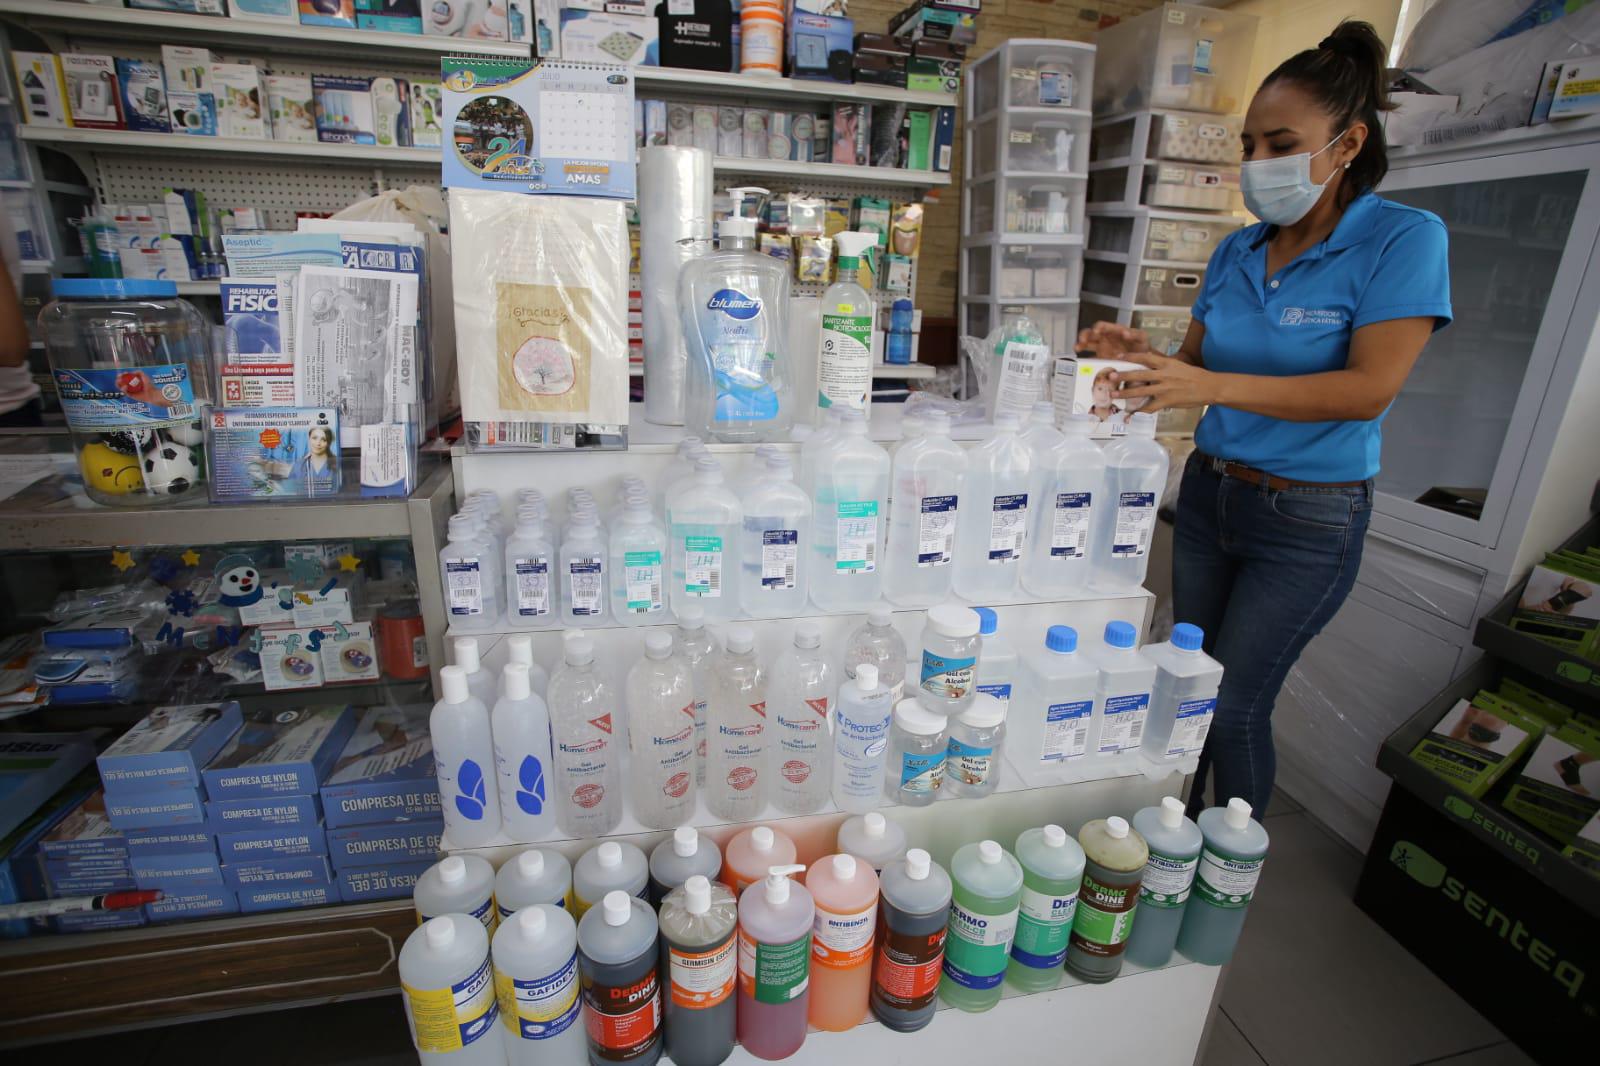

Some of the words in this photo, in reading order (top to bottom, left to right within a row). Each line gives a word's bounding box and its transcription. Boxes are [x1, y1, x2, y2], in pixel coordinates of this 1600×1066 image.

[566, 174, 601, 185] AMAS
[709, 297, 762, 309] blumen
[945, 677, 971, 685] Alcohol
[960, 763, 988, 773] Alcohol
[220, 778, 261, 788] COMPRESA
[262, 776, 273, 785] DE
[273, 772, 298, 784] NYLON
[341, 798, 404, 813] COMPRESA
[405, 796, 422, 808] DE
[222, 811, 261, 820] COMPRESA
[262, 808, 273, 818] DE
[273, 805, 299, 817] NYLON
[233, 840, 272, 851] COMPRESA
[274, 838, 284, 848] DE
[284, 835, 309, 847] NYLON
[346, 842, 406, 856] COMPRESA
[408, 840, 424, 851] DE
[426, 838, 441, 849] GE
[348, 879, 371, 893] GEL
[371, 877, 388, 890] DE
[389, 873, 418, 888] RESA
[1083, 875, 1128, 897] DERMO
[253, 892, 291, 904] COMPRESA
[291, 890, 301, 901] DE
[301, 888, 326, 900] NYLON
[1095, 892, 1125, 905] DINE
[527, 967, 575, 998] GAFIDEX
[610, 970, 657, 1000] DERMO
[628, 979, 657, 1004] DINE
